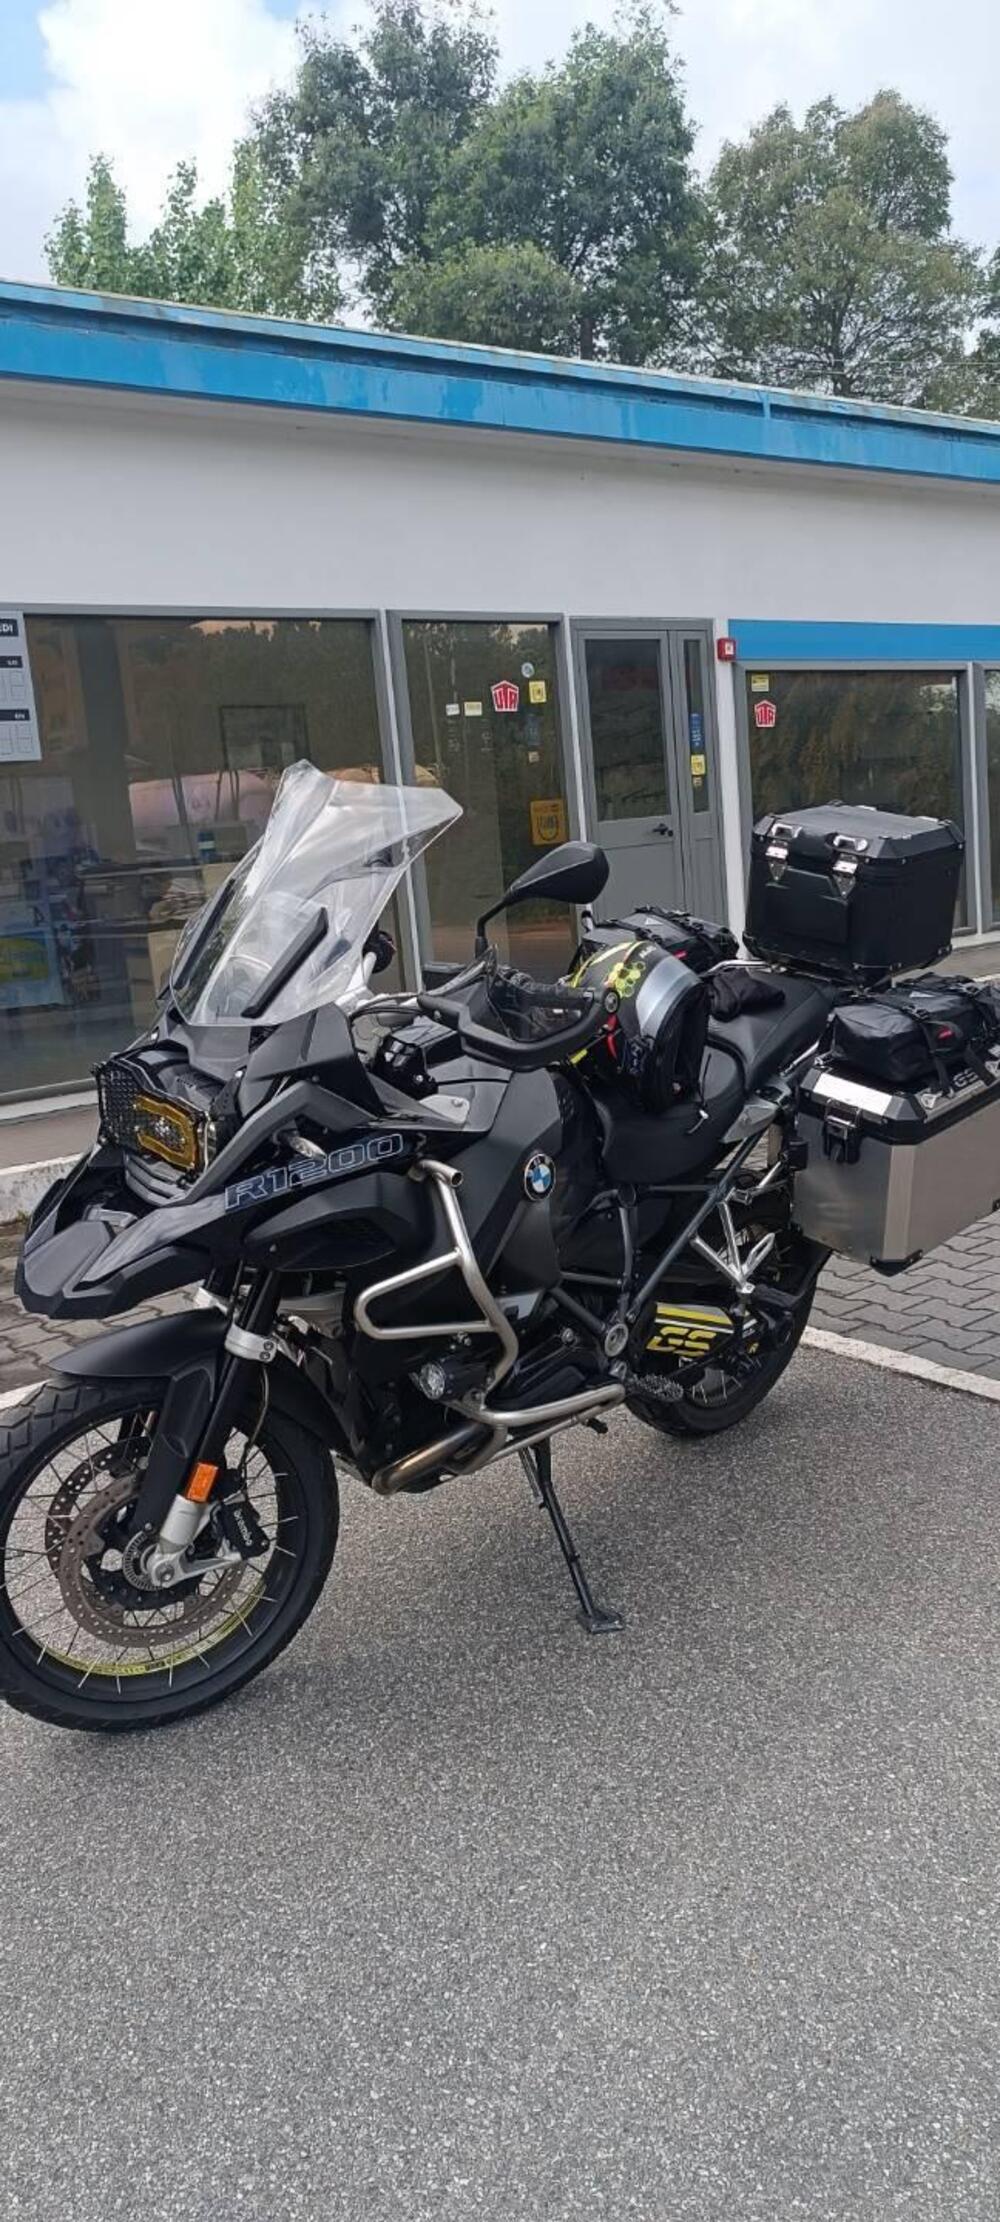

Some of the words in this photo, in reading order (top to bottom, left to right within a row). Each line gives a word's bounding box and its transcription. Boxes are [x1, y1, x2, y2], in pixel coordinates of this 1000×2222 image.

[492, 681, 519, 712] UTA
[953, 1067, 979, 1088] GS
[224, 1133, 403, 1211] R1200
[645, 1325, 717, 1358] GS
